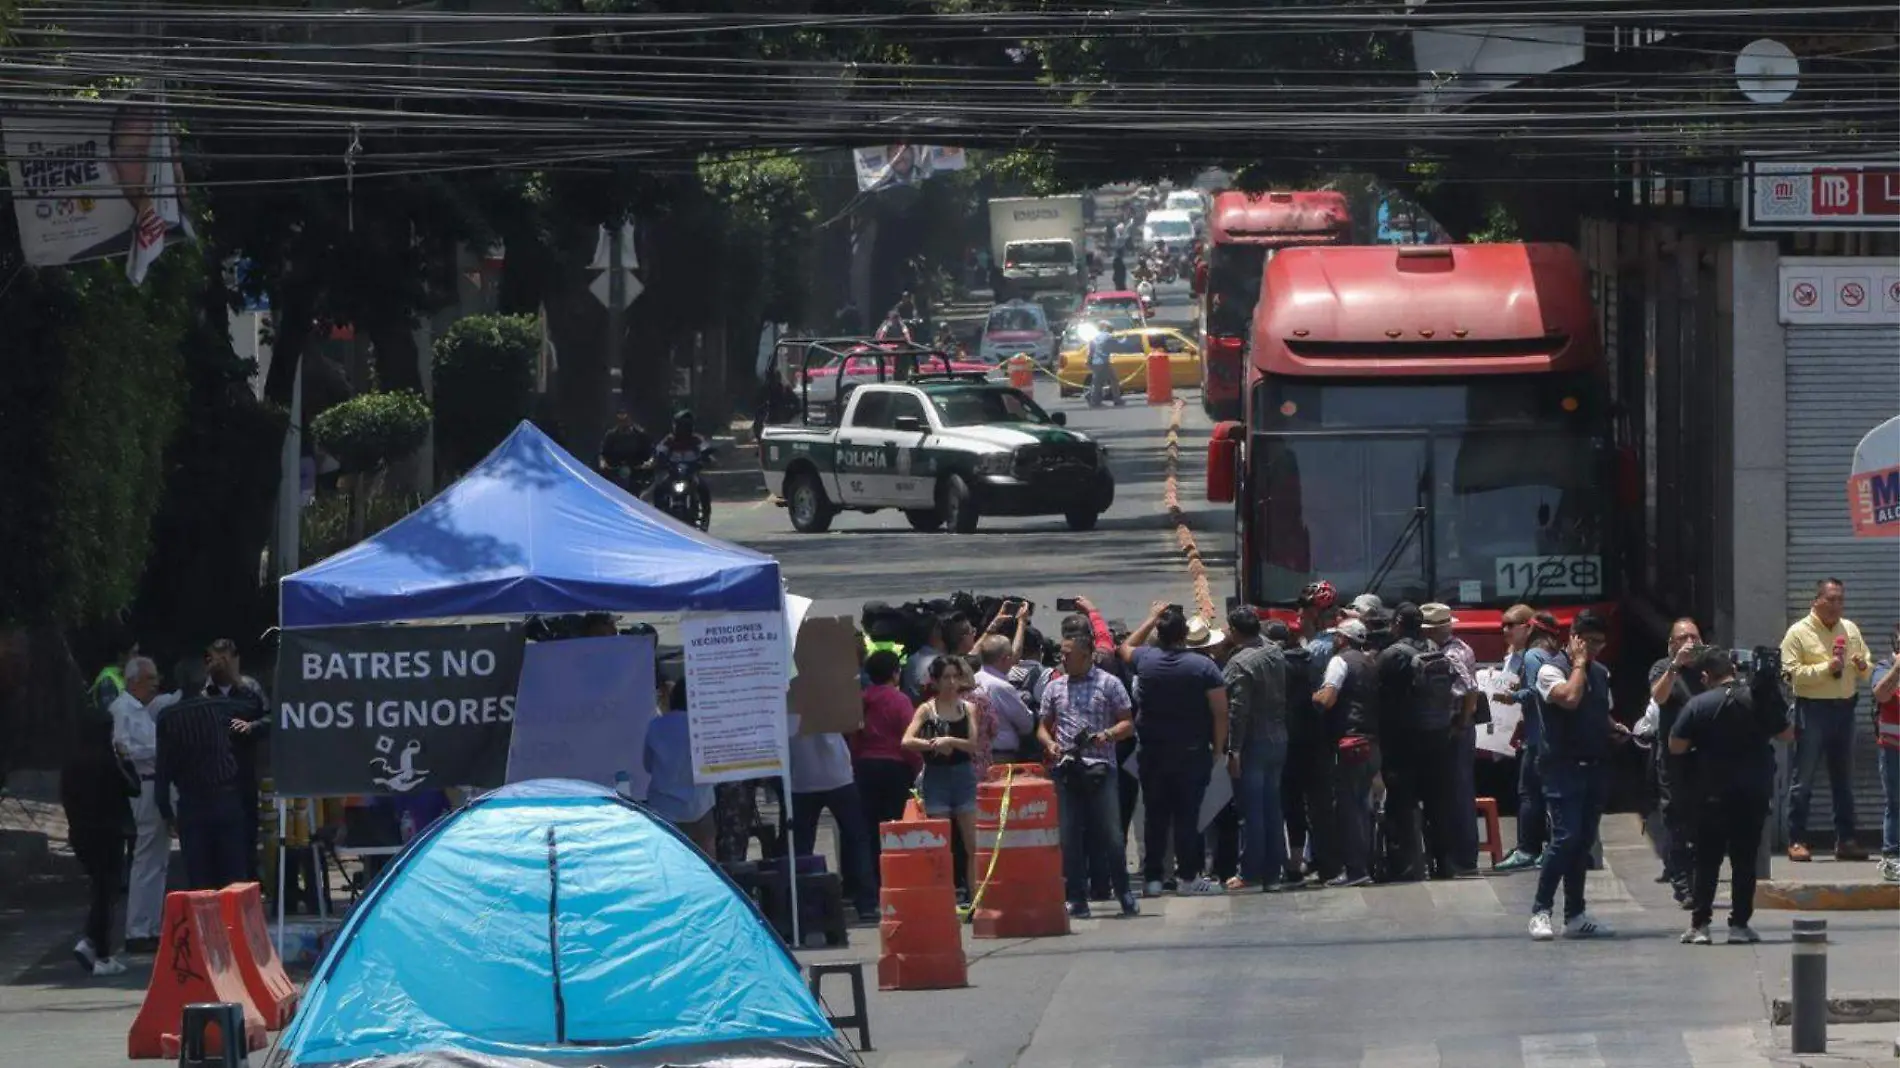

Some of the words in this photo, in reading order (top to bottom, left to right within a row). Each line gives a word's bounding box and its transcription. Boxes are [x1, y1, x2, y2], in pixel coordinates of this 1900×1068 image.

[23, 161, 100, 196] VIENE
[1820, 176, 1849, 206] MB
[836, 450, 887, 468] POLICÍA
[1856, 479, 1874, 524] LUIS
[1501, 559, 1599, 589] 1128
[691, 635, 734, 647] VECINOS
[737, 634, 749, 643] DE
[751, 633, 764, 642] LA
[705, 624, 762, 636] PETICIONES
[302, 650, 432, 680] BATRES
[442, 649, 496, 677] NO
[280, 701, 354, 729] NOS
[365, 695, 516, 727] IGNORES
